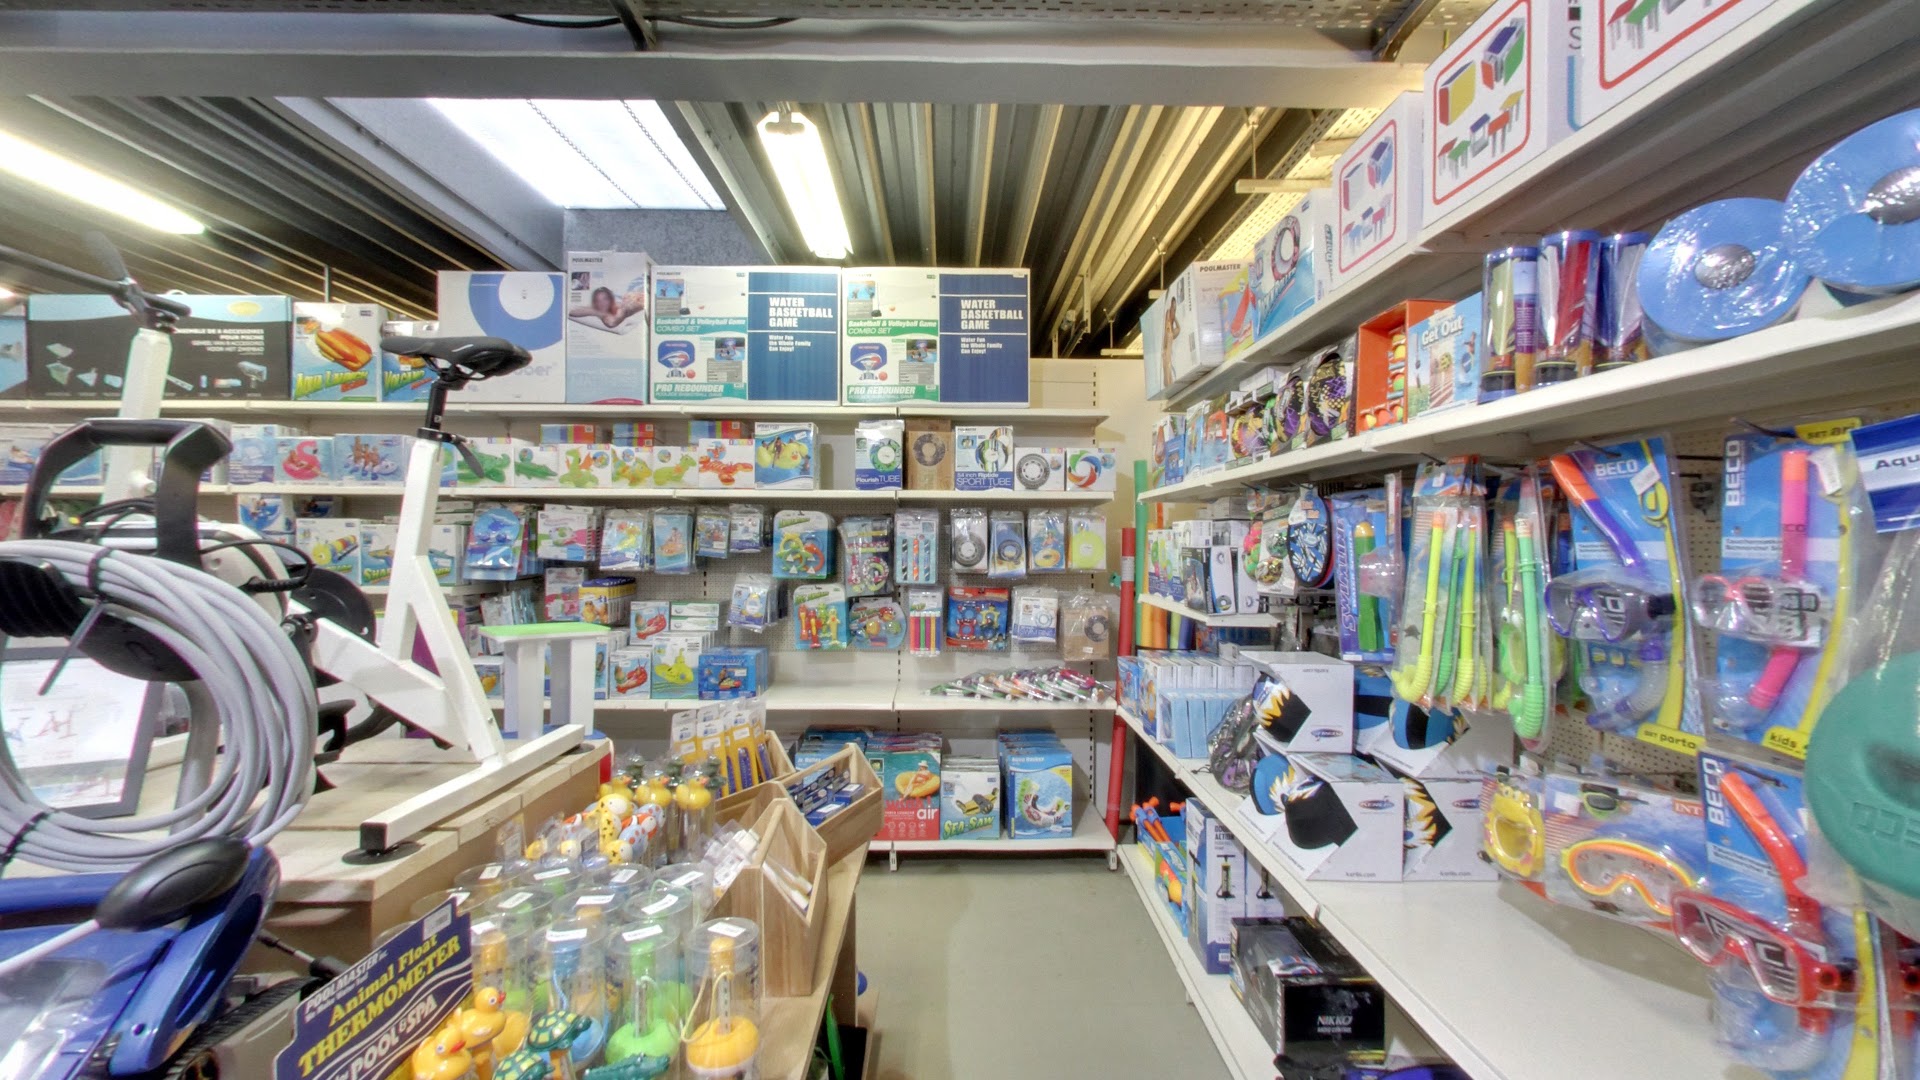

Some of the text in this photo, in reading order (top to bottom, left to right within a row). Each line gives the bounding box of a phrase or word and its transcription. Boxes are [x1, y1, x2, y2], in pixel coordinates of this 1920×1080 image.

[1199, 263, 1241, 272] POOLMASTER
[769, 297, 805, 307] WATER
[960, 299, 996, 309] WATER
[769, 307, 834, 318] BASKETBALL
[960, 310, 1024, 320] BASKETBALL
[769, 318, 798, 328] GAME
[888, 320, 918, 328] Volleyball
[960, 320, 990, 330] GAME
[1421, 315, 1464, 347] Get Out
[656, 384, 724, 393] PRO REBOUNDER
[849, 386, 915, 394] PRO REBOUNDER
[1594, 459, 1639, 477] BECO
[1875, 455, 1920, 470] Aqu
[1725, 440, 1741, 506] BECO
[879, 475, 900, 483] TUBE
[957, 478, 1012, 486] SPORT TUBE
[1770, 732, 1797, 749] kids
[1702, 757, 1726, 827] BECO
[916, 804, 940, 820] air
[1674, 801, 1703, 817] INT
[304, 950, 380, 1014] POOLMASTER
[329, 933, 438, 1027] Animal Float
[298, 935, 461, 1078] THERMOMETER
[1316, 1015, 1354, 1026] NIKKO
[349, 1028, 400, 1080] POOL
[405, 994, 438, 1034] SPA
